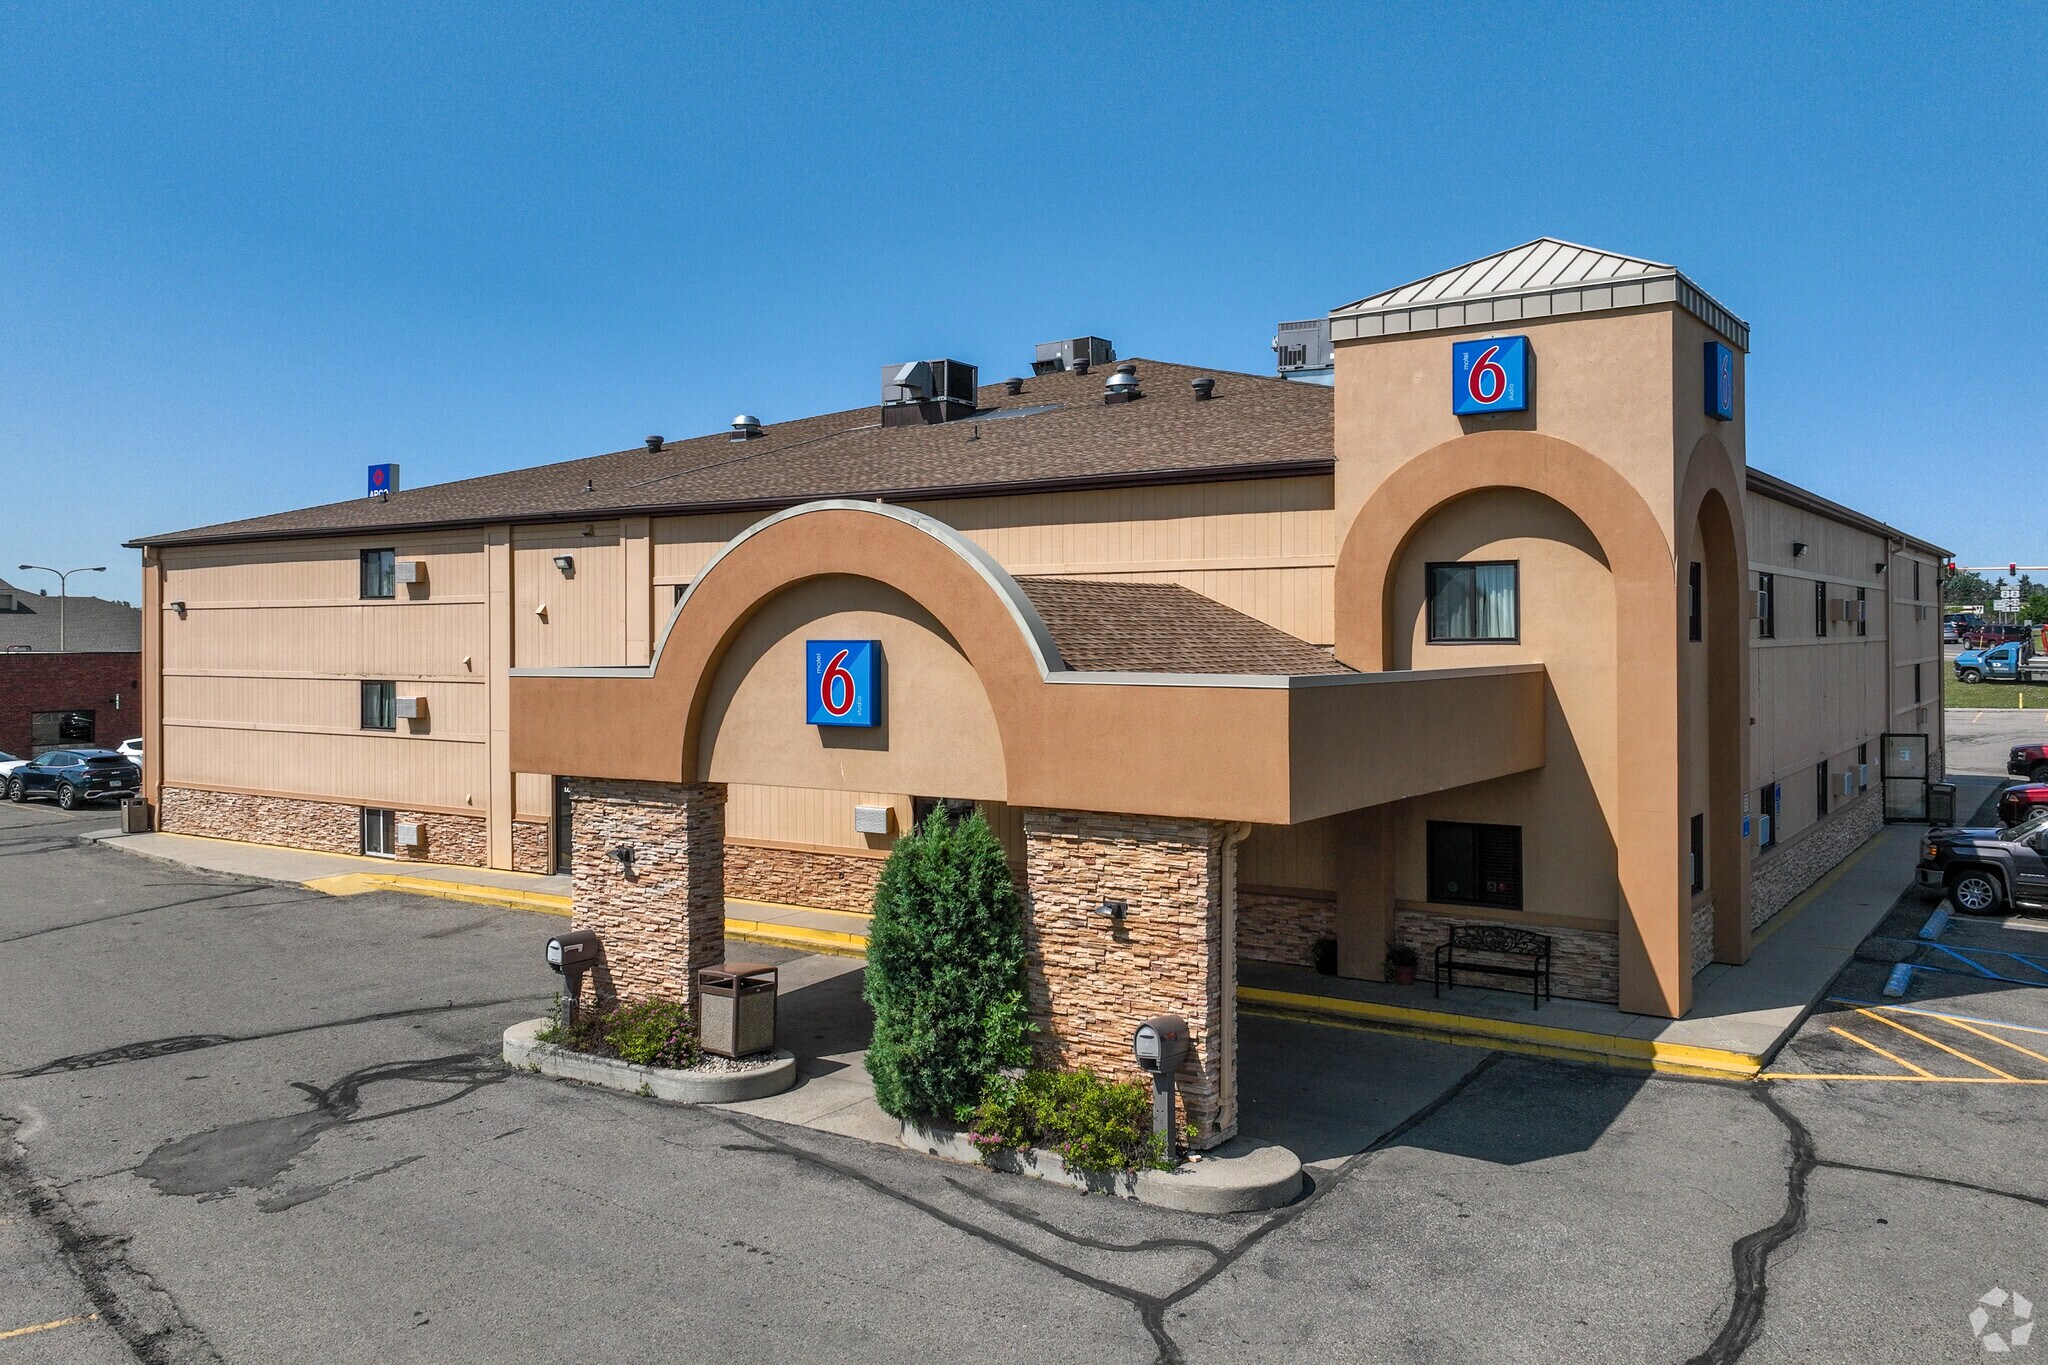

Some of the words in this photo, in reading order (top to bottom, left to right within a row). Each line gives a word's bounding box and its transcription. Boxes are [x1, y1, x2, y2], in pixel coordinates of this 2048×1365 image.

[1468, 346, 1507, 405] 6
[1721, 355, 1730, 410] 6
[820, 649, 856, 717] 6
